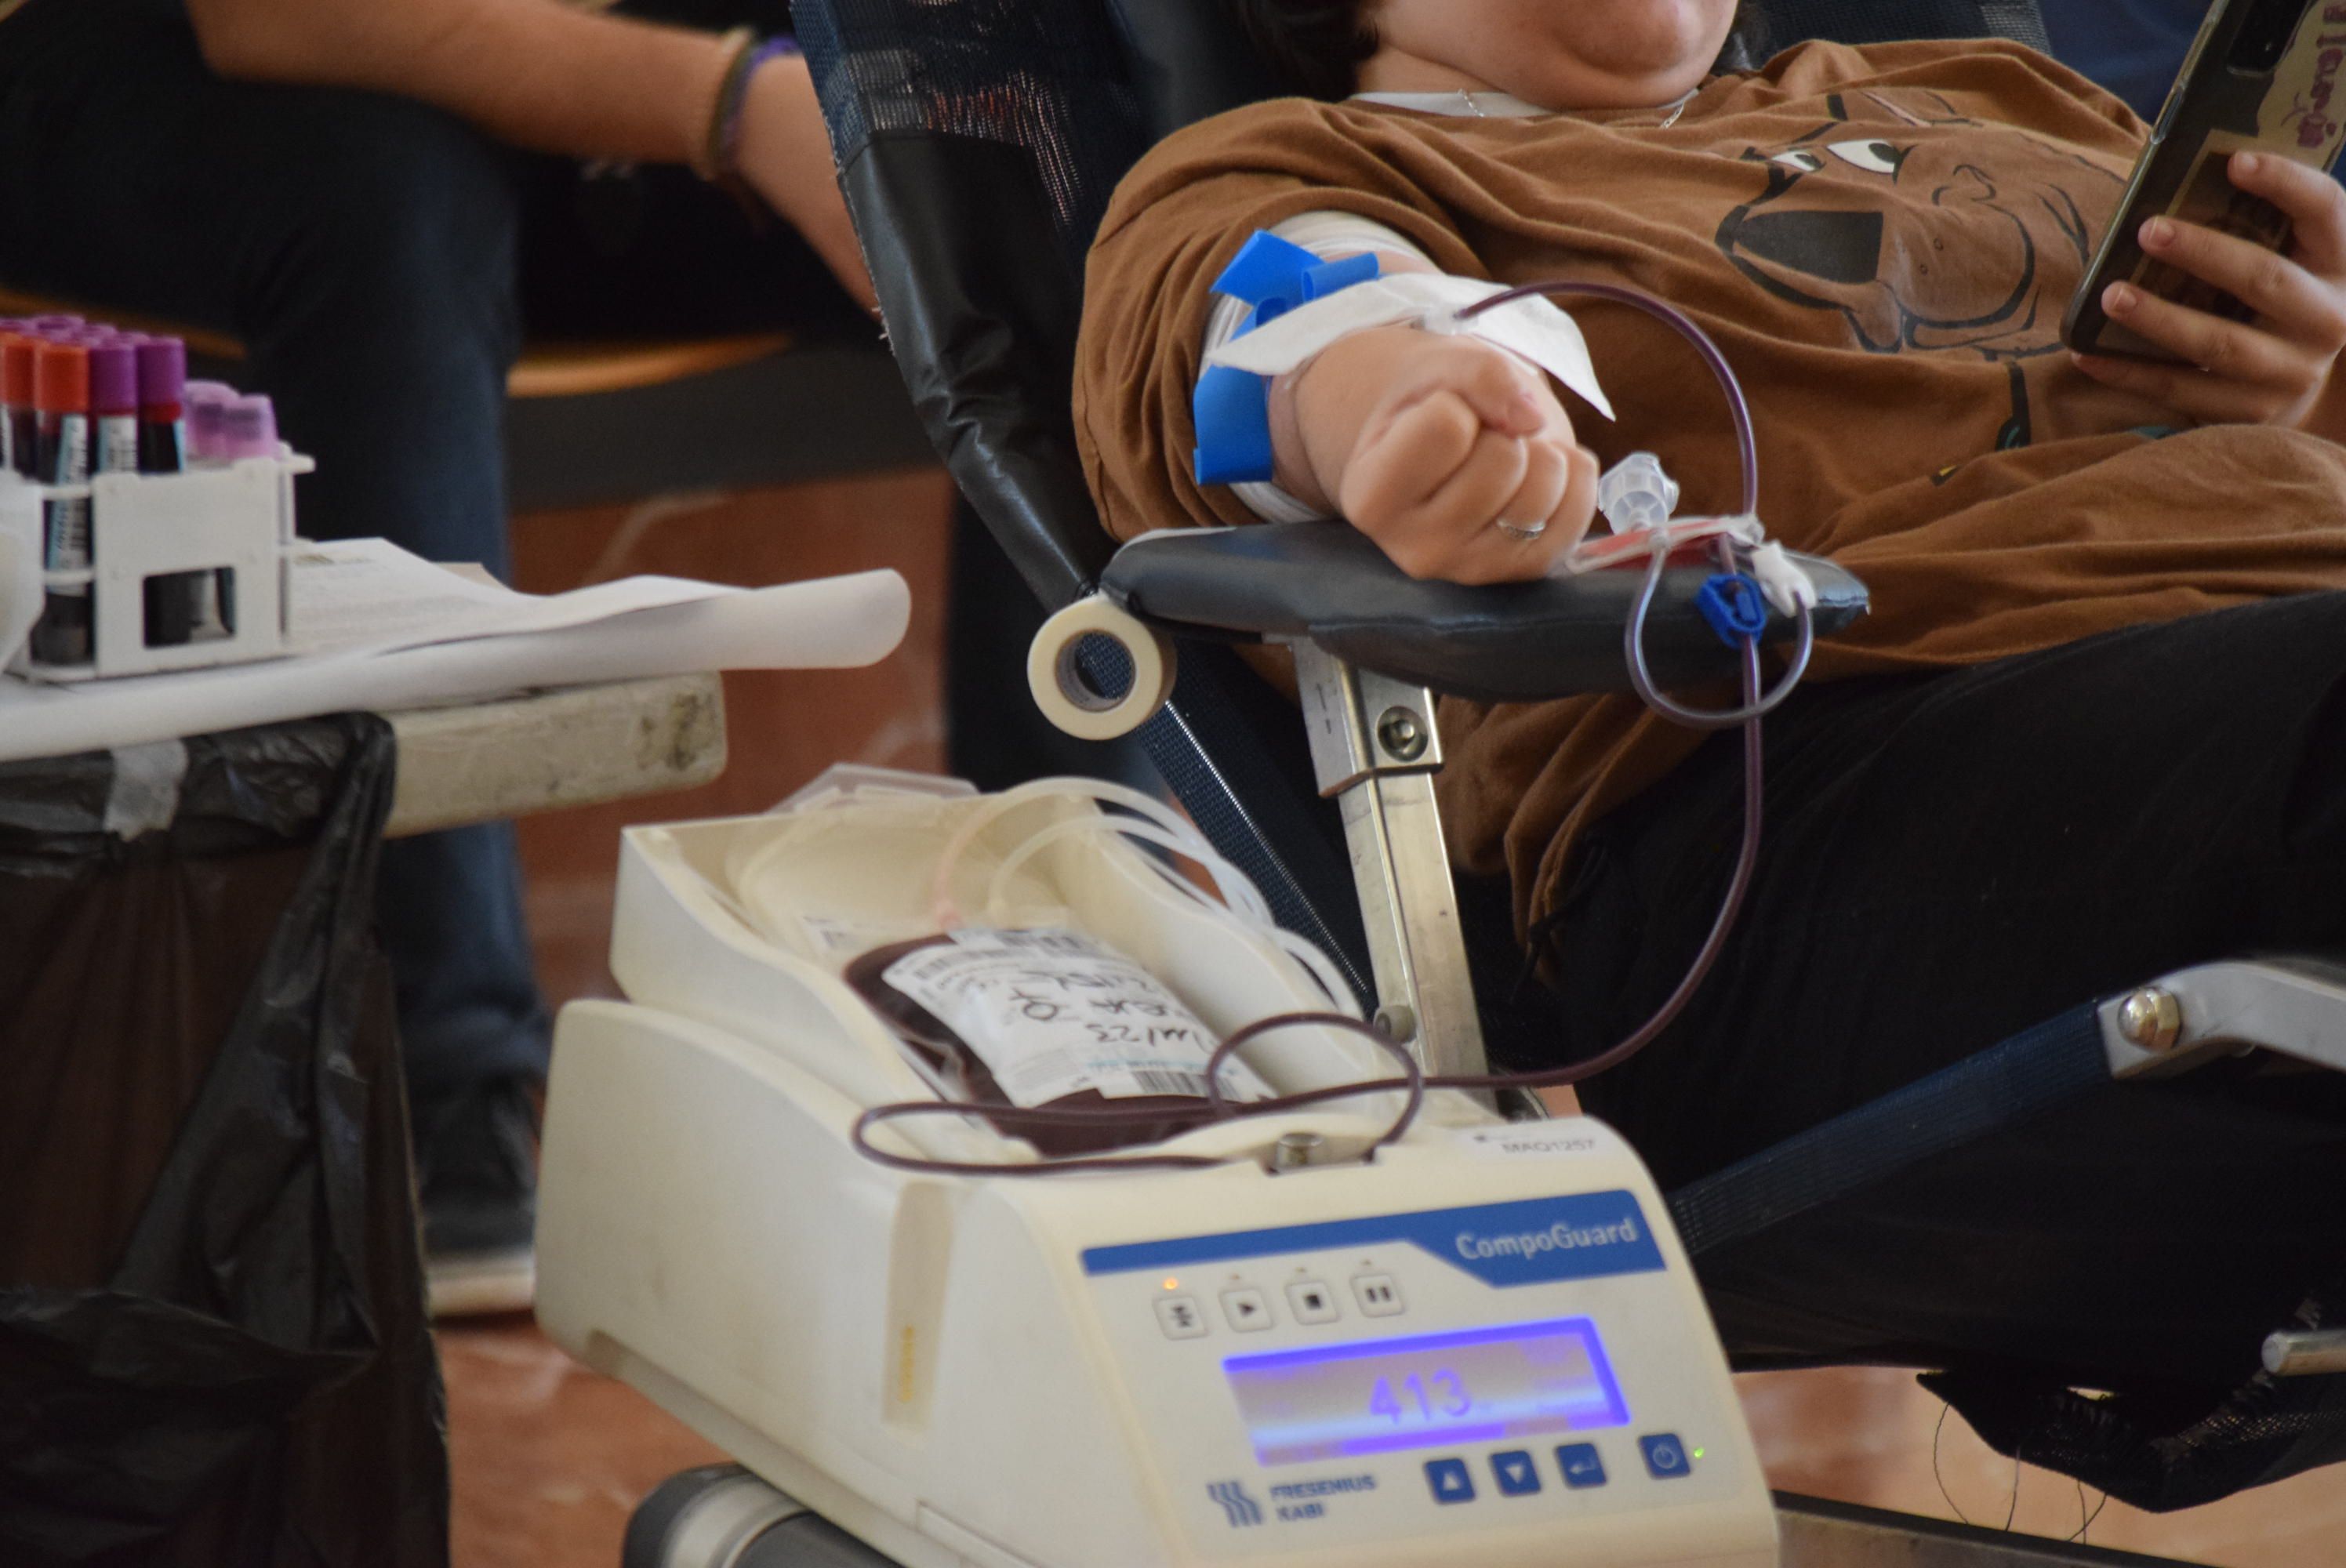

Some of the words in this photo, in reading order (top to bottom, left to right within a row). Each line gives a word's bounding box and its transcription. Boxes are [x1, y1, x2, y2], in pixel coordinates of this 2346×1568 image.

[1455, 1217, 1638, 1260] CompoGuard
[1369, 1367, 1472, 1425] 413
[1269, 1475, 1377, 1500] FRESENIUS
[1276, 1502, 1325, 1521] KABI
